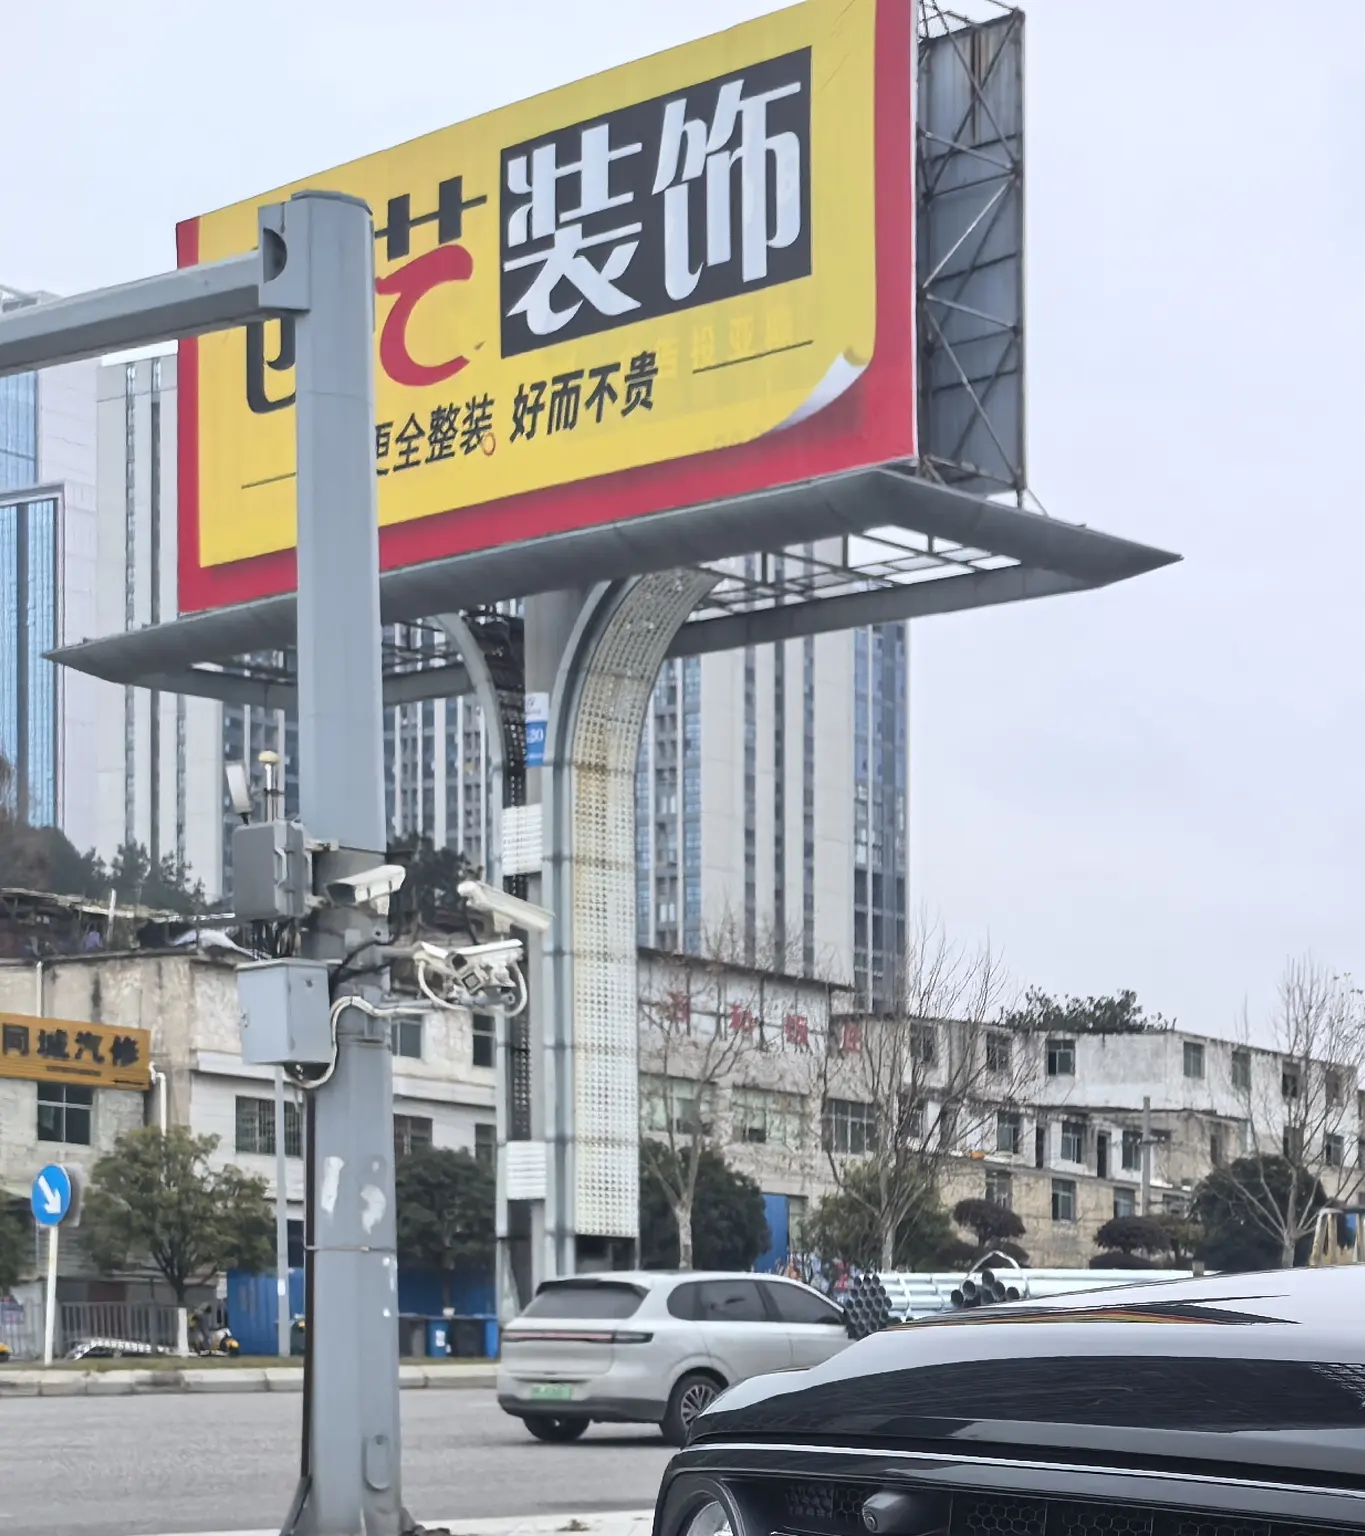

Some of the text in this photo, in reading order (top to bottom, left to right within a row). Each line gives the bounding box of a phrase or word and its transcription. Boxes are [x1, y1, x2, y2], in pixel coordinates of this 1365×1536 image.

[247, 78, 801, 414] 艺装饰
[509, 351, 659, 443] 好而不贵
